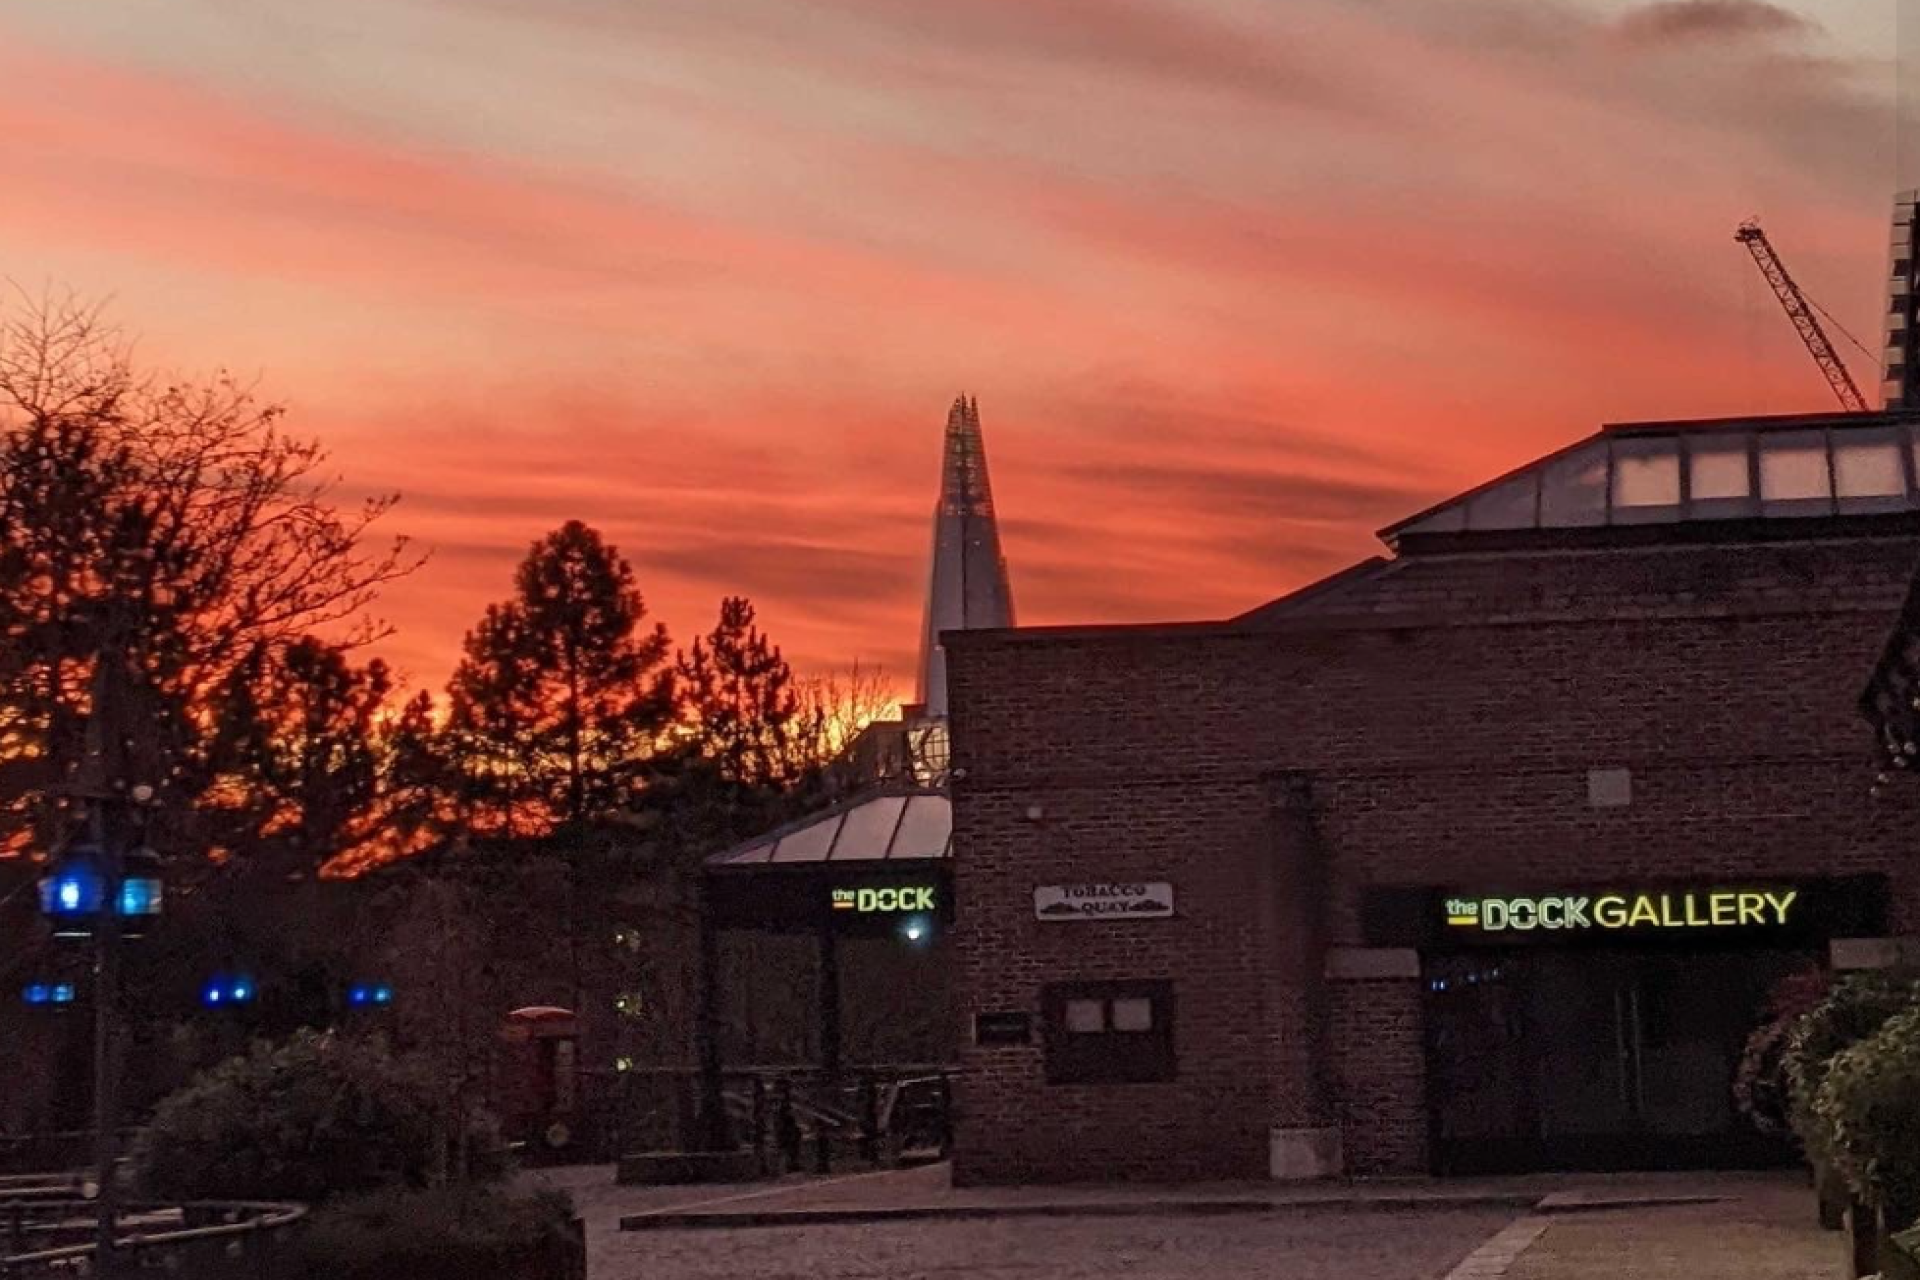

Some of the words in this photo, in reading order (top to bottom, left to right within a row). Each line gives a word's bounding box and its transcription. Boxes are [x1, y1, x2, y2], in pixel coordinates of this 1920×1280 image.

[832, 889, 855, 901] the
[858, 887, 935, 911] DOCK
[1063, 882, 1146, 898] TOBACCO
[1081, 901, 1129, 916] QUAY
[1446, 899, 1478, 915] the
[1482, 897, 1591, 930] DOCK
[1594, 891, 1797, 928] GALLERY
